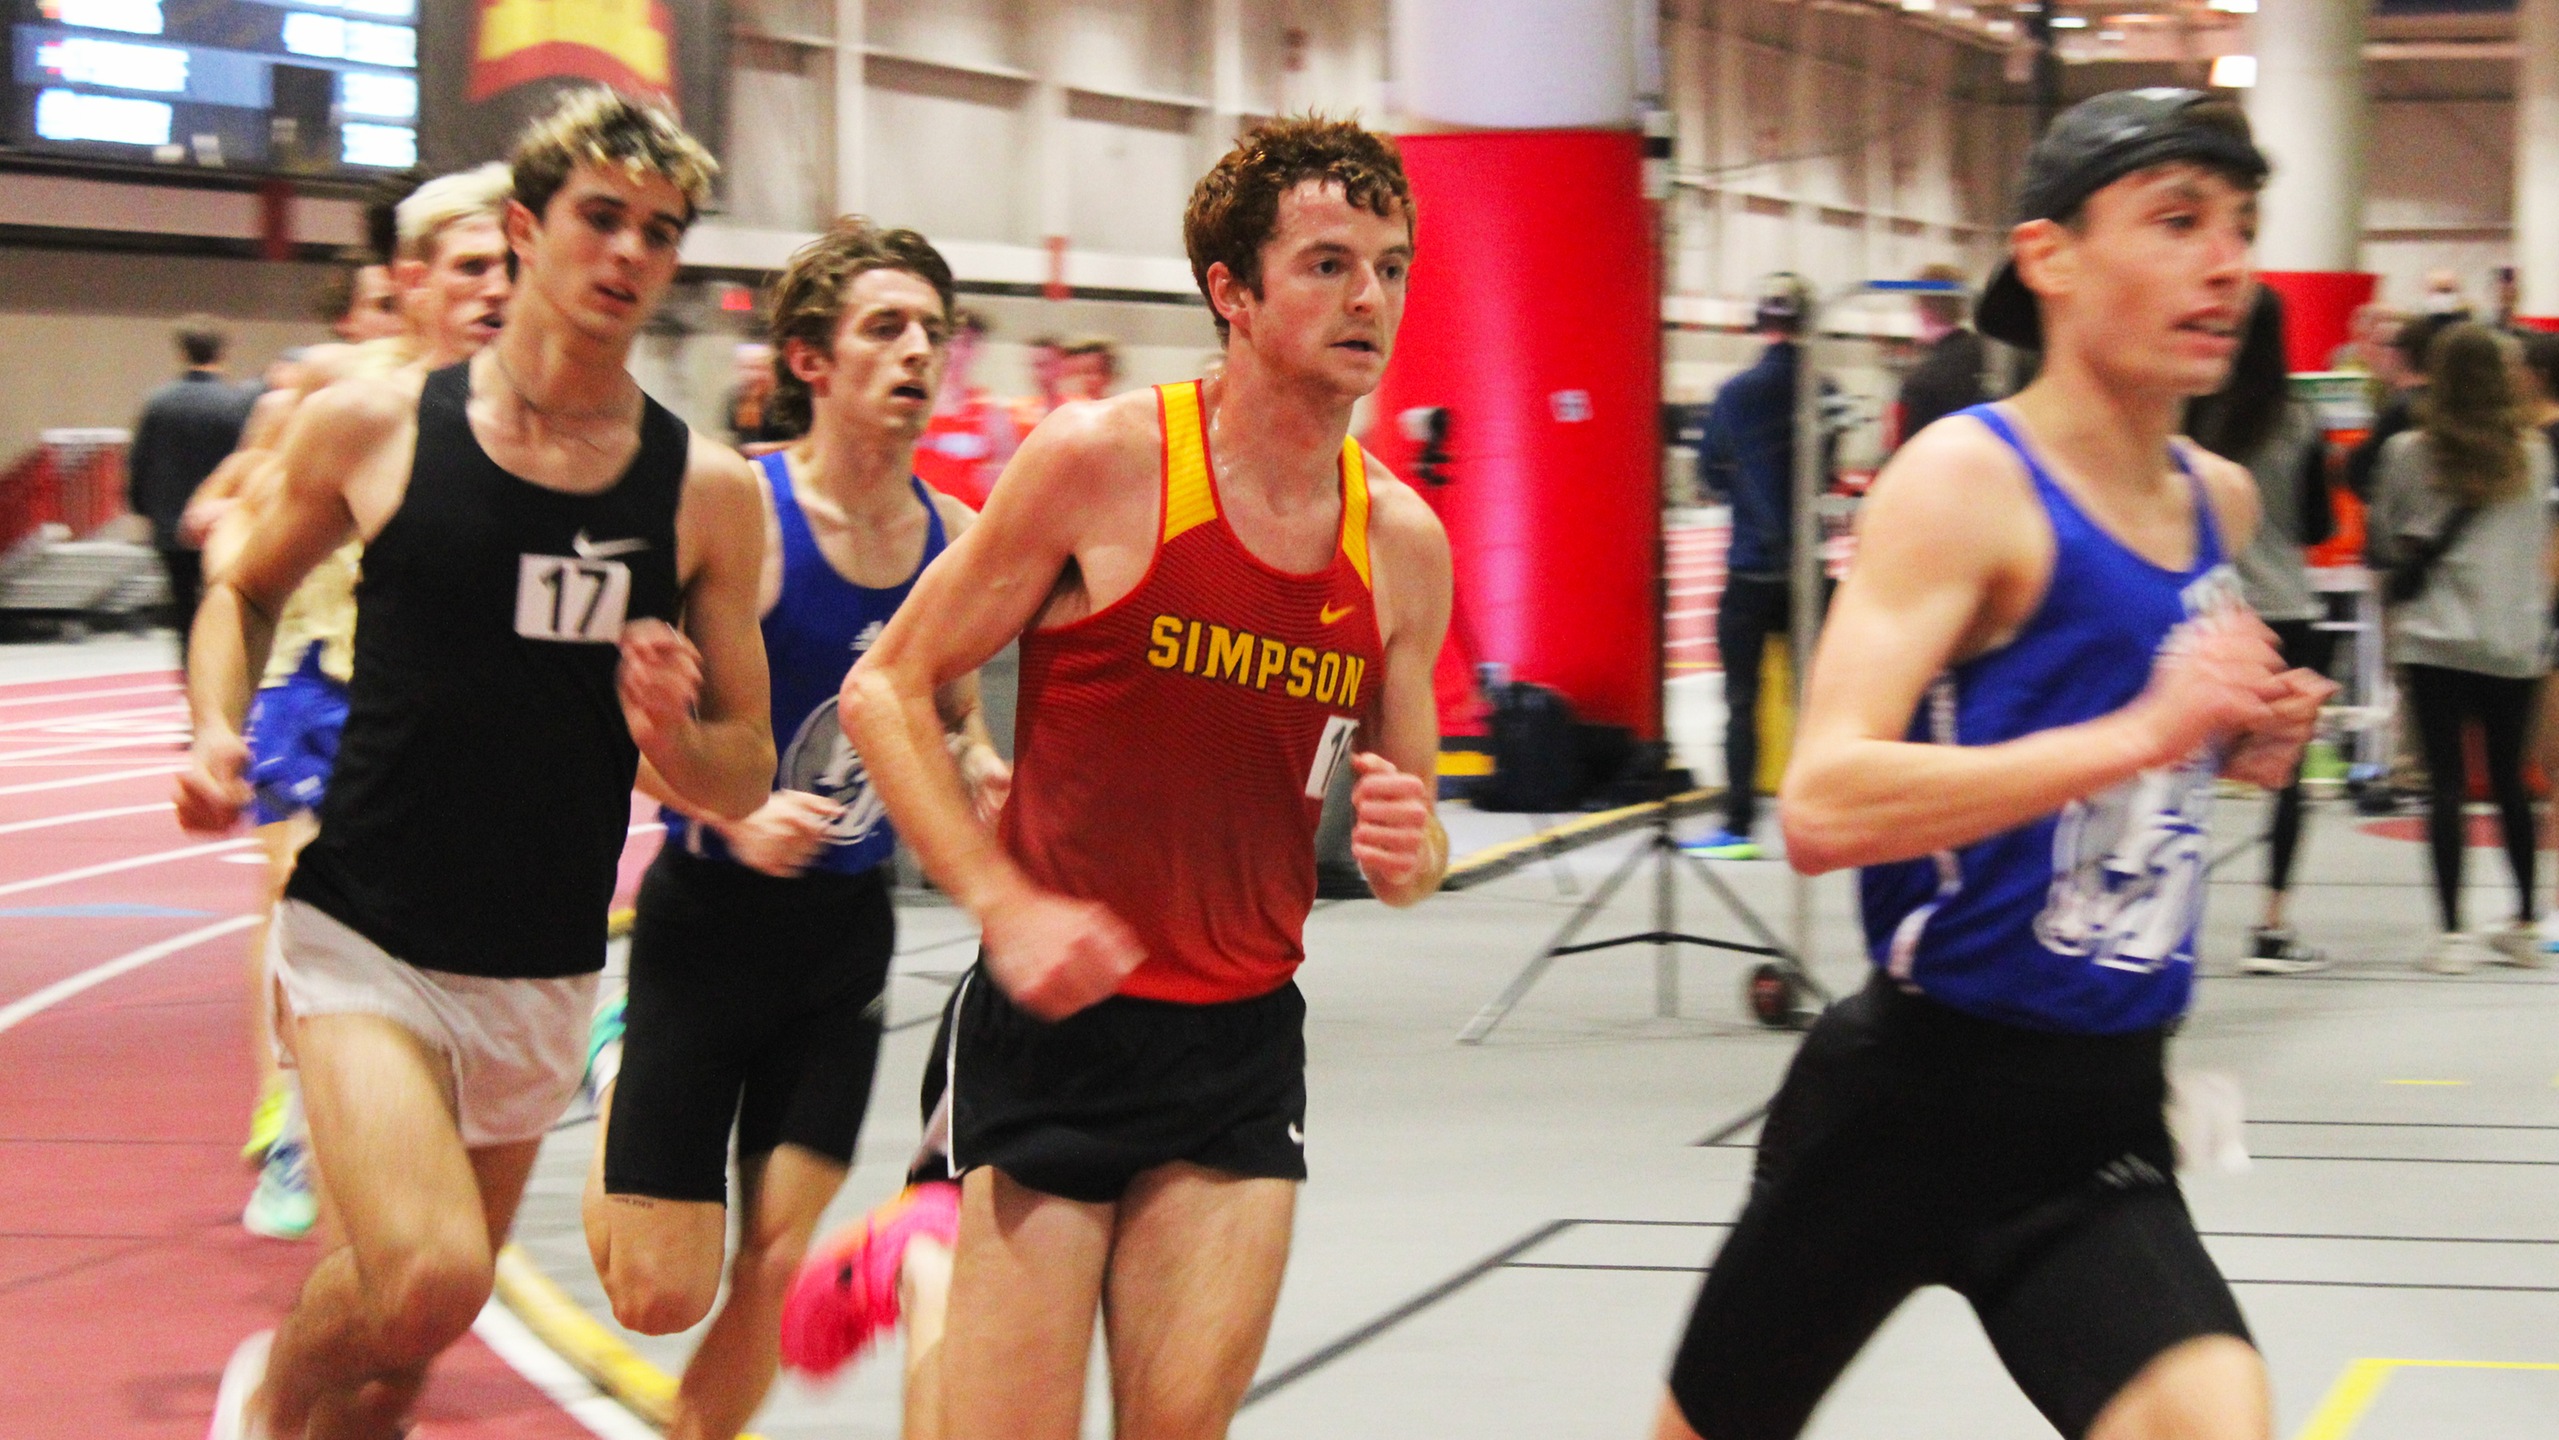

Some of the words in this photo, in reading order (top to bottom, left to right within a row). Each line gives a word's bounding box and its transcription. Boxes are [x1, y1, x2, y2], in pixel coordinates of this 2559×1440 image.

[539, 564, 609, 634] 17
[1147, 613, 1367, 708] SIMPSON
[1320, 724, 1358, 795] 1
